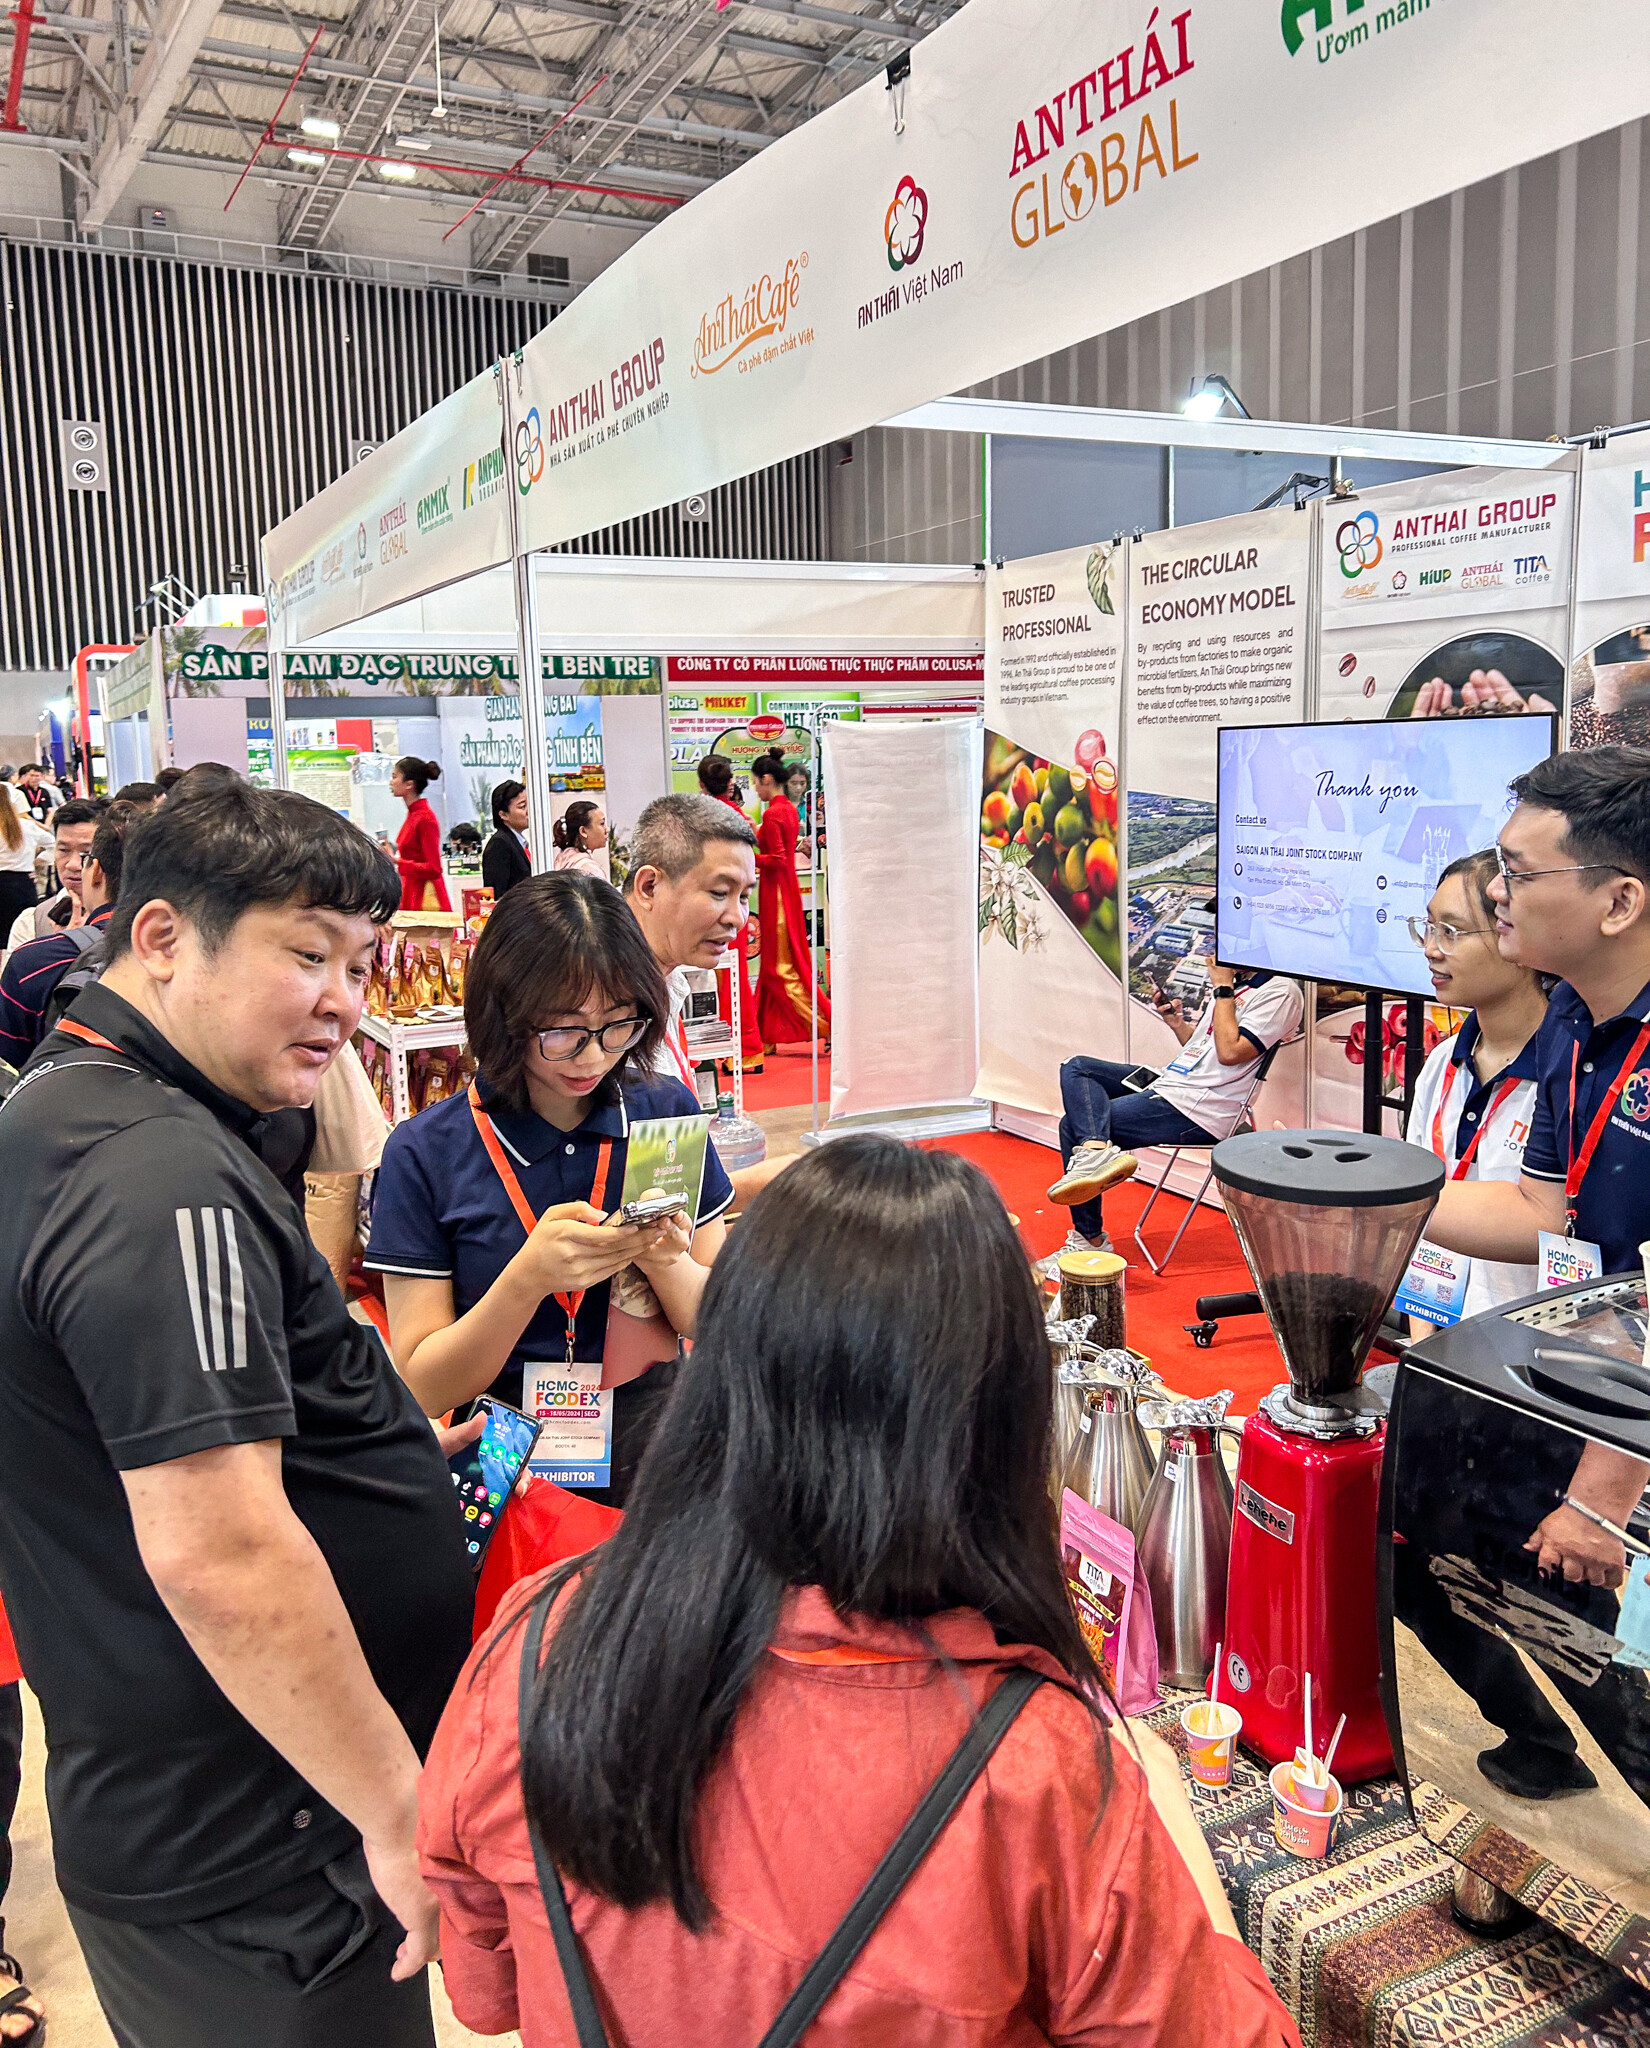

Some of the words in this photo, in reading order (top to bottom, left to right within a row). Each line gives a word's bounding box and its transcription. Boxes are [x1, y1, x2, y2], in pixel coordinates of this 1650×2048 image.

[1317, 22, 1369, 63] Ươm
[1009, 6, 1195, 178] ANTHÁI
[1010, 99, 1199, 248] GLOBAL
[858, 305, 873, 329] AN
[903, 274, 928, 305] Việt
[931, 260, 963, 288] Nam
[738, 359, 748, 374] Cà
[749, 353, 762, 373] phê
[763, 346, 779, 363] đậm
[780, 334, 796, 354] chất
[797, 328, 815, 346] Việt
[550, 380, 604, 446] ANTHAI
[611, 337, 665, 411] GROUP
[417, 484, 449, 529] ANMIX
[1393, 509, 1467, 540] ANTHAI
[1478, 494, 1557, 527] GROUP
[1392, 538, 1446, 553] PROFESSIONAL
[1450, 533, 1477, 544] COFFEE
[1481, 521, 1551, 539] MANUFACTURER
[1142, 563, 1169, 585] THE
[1172, 548, 1258, 581] CIRCULAR
[1461, 561, 1503, 577] ANTHÁI
[1514, 555, 1548, 574] TITA
[1515, 574, 1550, 584] coffee
[1003, 584, 1055, 608] TRUSTED
[1142, 594, 1226, 624] ECONOMY
[1230, 585, 1295, 613] MODEL
[1003, 615, 1091, 641] PROFESSIONAL
[1138, 643, 1147, 654] By
[1152, 640, 1181, 652] recycling
[1188, 637, 1200, 648] and
[1207, 635, 1226, 647] using
[1233, 631, 1270, 643] resources
[1278, 627, 1293, 638] and
[184, 646, 243, 676] SẢN
[611, 656, 650, 676] TRE
[714, 657, 730, 671] TY
[1074, 647, 1109, 658] established
[1111, 647, 1116, 655] in
[1138, 655, 1178, 669] by-products
[1180, 653, 1196, 663] from
[1197, 651, 1228, 662] factories
[1230, 649, 1239, 659] to
[1241, 646, 1261, 657] make
[1263, 644, 1292, 657] organic
[1033, 667, 1050, 676] Group
[1057, 664, 1075, 675] proud
[1077, 664, 1083, 672] to
[1084, 663, 1093, 671] be
[1108, 661, 1115, 669] of
[1138, 670, 1167, 681] microbial
[1200, 667, 1210, 676] An
[1226, 663, 1249, 675] Group
[1251, 662, 1274, 673] brings
[1275, 661, 1292, 670] new
[1060, 679, 1078, 687] coffee
[1080, 676, 1115, 686] processing
[1166, 684, 1181, 694] from
[1183, 681, 1226, 695] by-products
[1228, 679, 1247, 690] while
[1249, 676, 1291, 689] maximizing
[1137, 700, 1149, 710] the
[1150, 698, 1166, 710] value
[1168, 698, 1175, 709] of
[1176, 697, 1197, 708] coffee
[1220, 697, 1229, 706] so
[1229, 694, 1253, 707] having
[1261, 693, 1291, 705] positive
[1137, 714, 1159, 724] effect
[1316, 770, 1373, 796] Thank
[1379, 785, 1419, 813] you
[1235, 814, 1258, 824] Contact
[1236, 845, 1259, 856] SAIGON
[1260, 846, 1269, 856] AN
[1270, 847, 1284, 857] THAI
[1286, 848, 1304, 858] JOINT
[1305, 849, 1327, 860] STOCK
[1328, 850, 1363, 862] COMPANY
[1419, 1247, 1441, 1259] HCMC
[1548, 1249, 1576, 1264] HCMC
[1578, 1260, 1593, 1269] 2024
[1405, 1302, 1449, 1324] EXHIBITOR
[537, 1381, 578, 1391] HCMC
[1086, 1562, 1105, 1585] TITA
